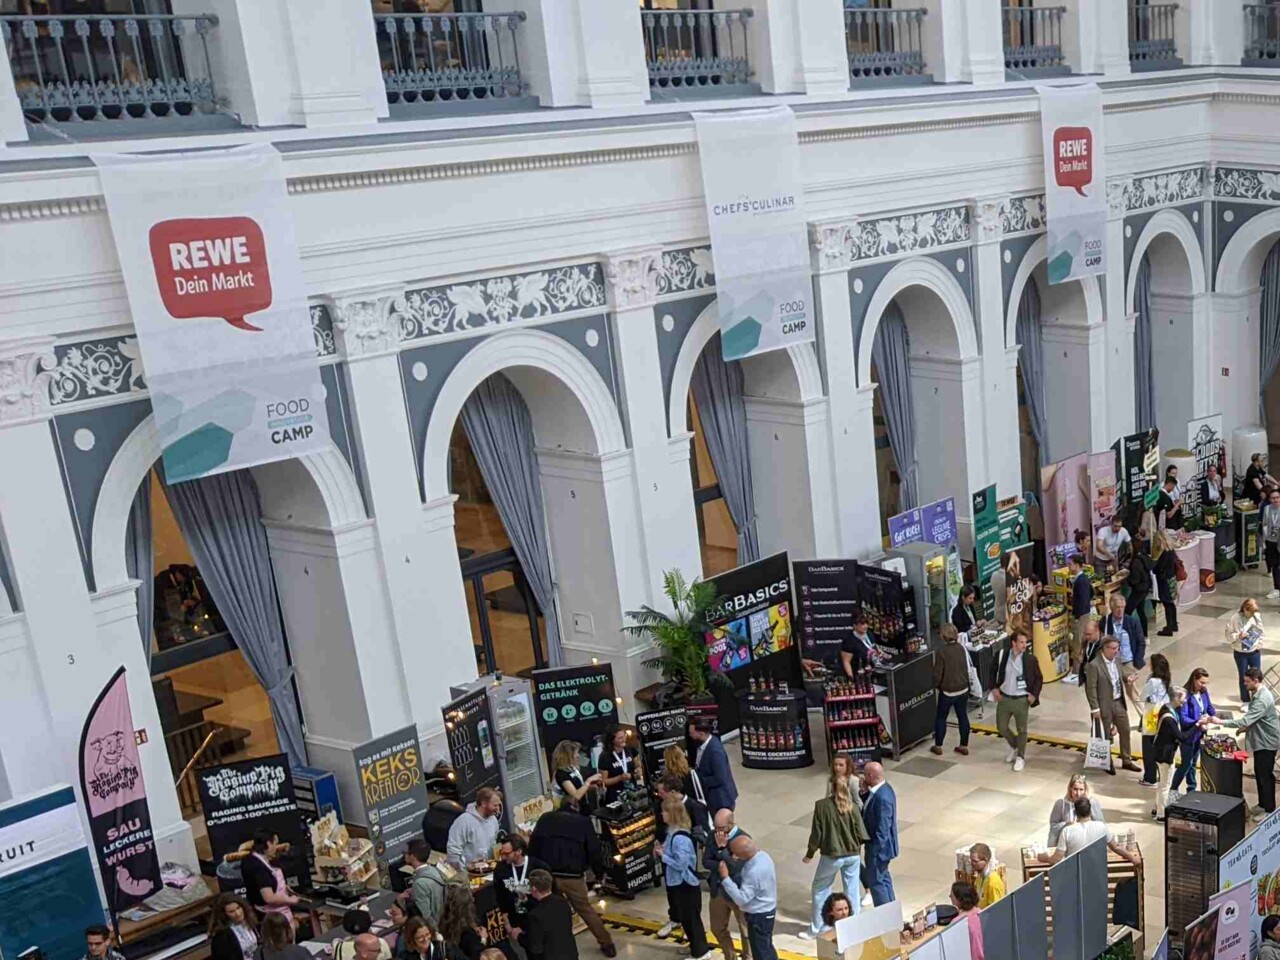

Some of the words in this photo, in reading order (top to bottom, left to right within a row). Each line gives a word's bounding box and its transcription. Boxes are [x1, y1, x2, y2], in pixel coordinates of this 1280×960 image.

[1059, 139, 1088, 158] REWE
[168, 236, 250, 271] REWE
[174, 275, 208, 295] Dein
[212, 270, 255, 291] Markt
[780, 300, 805, 314] FOOD
[782, 321, 806, 335] CAMP
[266, 398, 310, 418] FOOD
[271, 425, 314, 444] CAMP
[67, 654, 75, 665] 3
[538, 681, 557, 690] DAS
[556, 674, 609, 687] ELEKTROLYT-
[540, 688, 579, 700] GETRÄNK
[360, 748, 418, 786] KEKS
[203, 771, 257, 797] Raging
[255, 765, 286, 784] Pig
[219, 779, 280, 803] Company
[364, 767, 421, 806] KREATOR
[211, 805, 247, 818] RAGING
[247, 798, 290, 810] SAUSAGE
[107, 818, 142, 841] SAU
[103, 830, 152, 853] LECKERE
[105, 841, 155, 866] WURST
